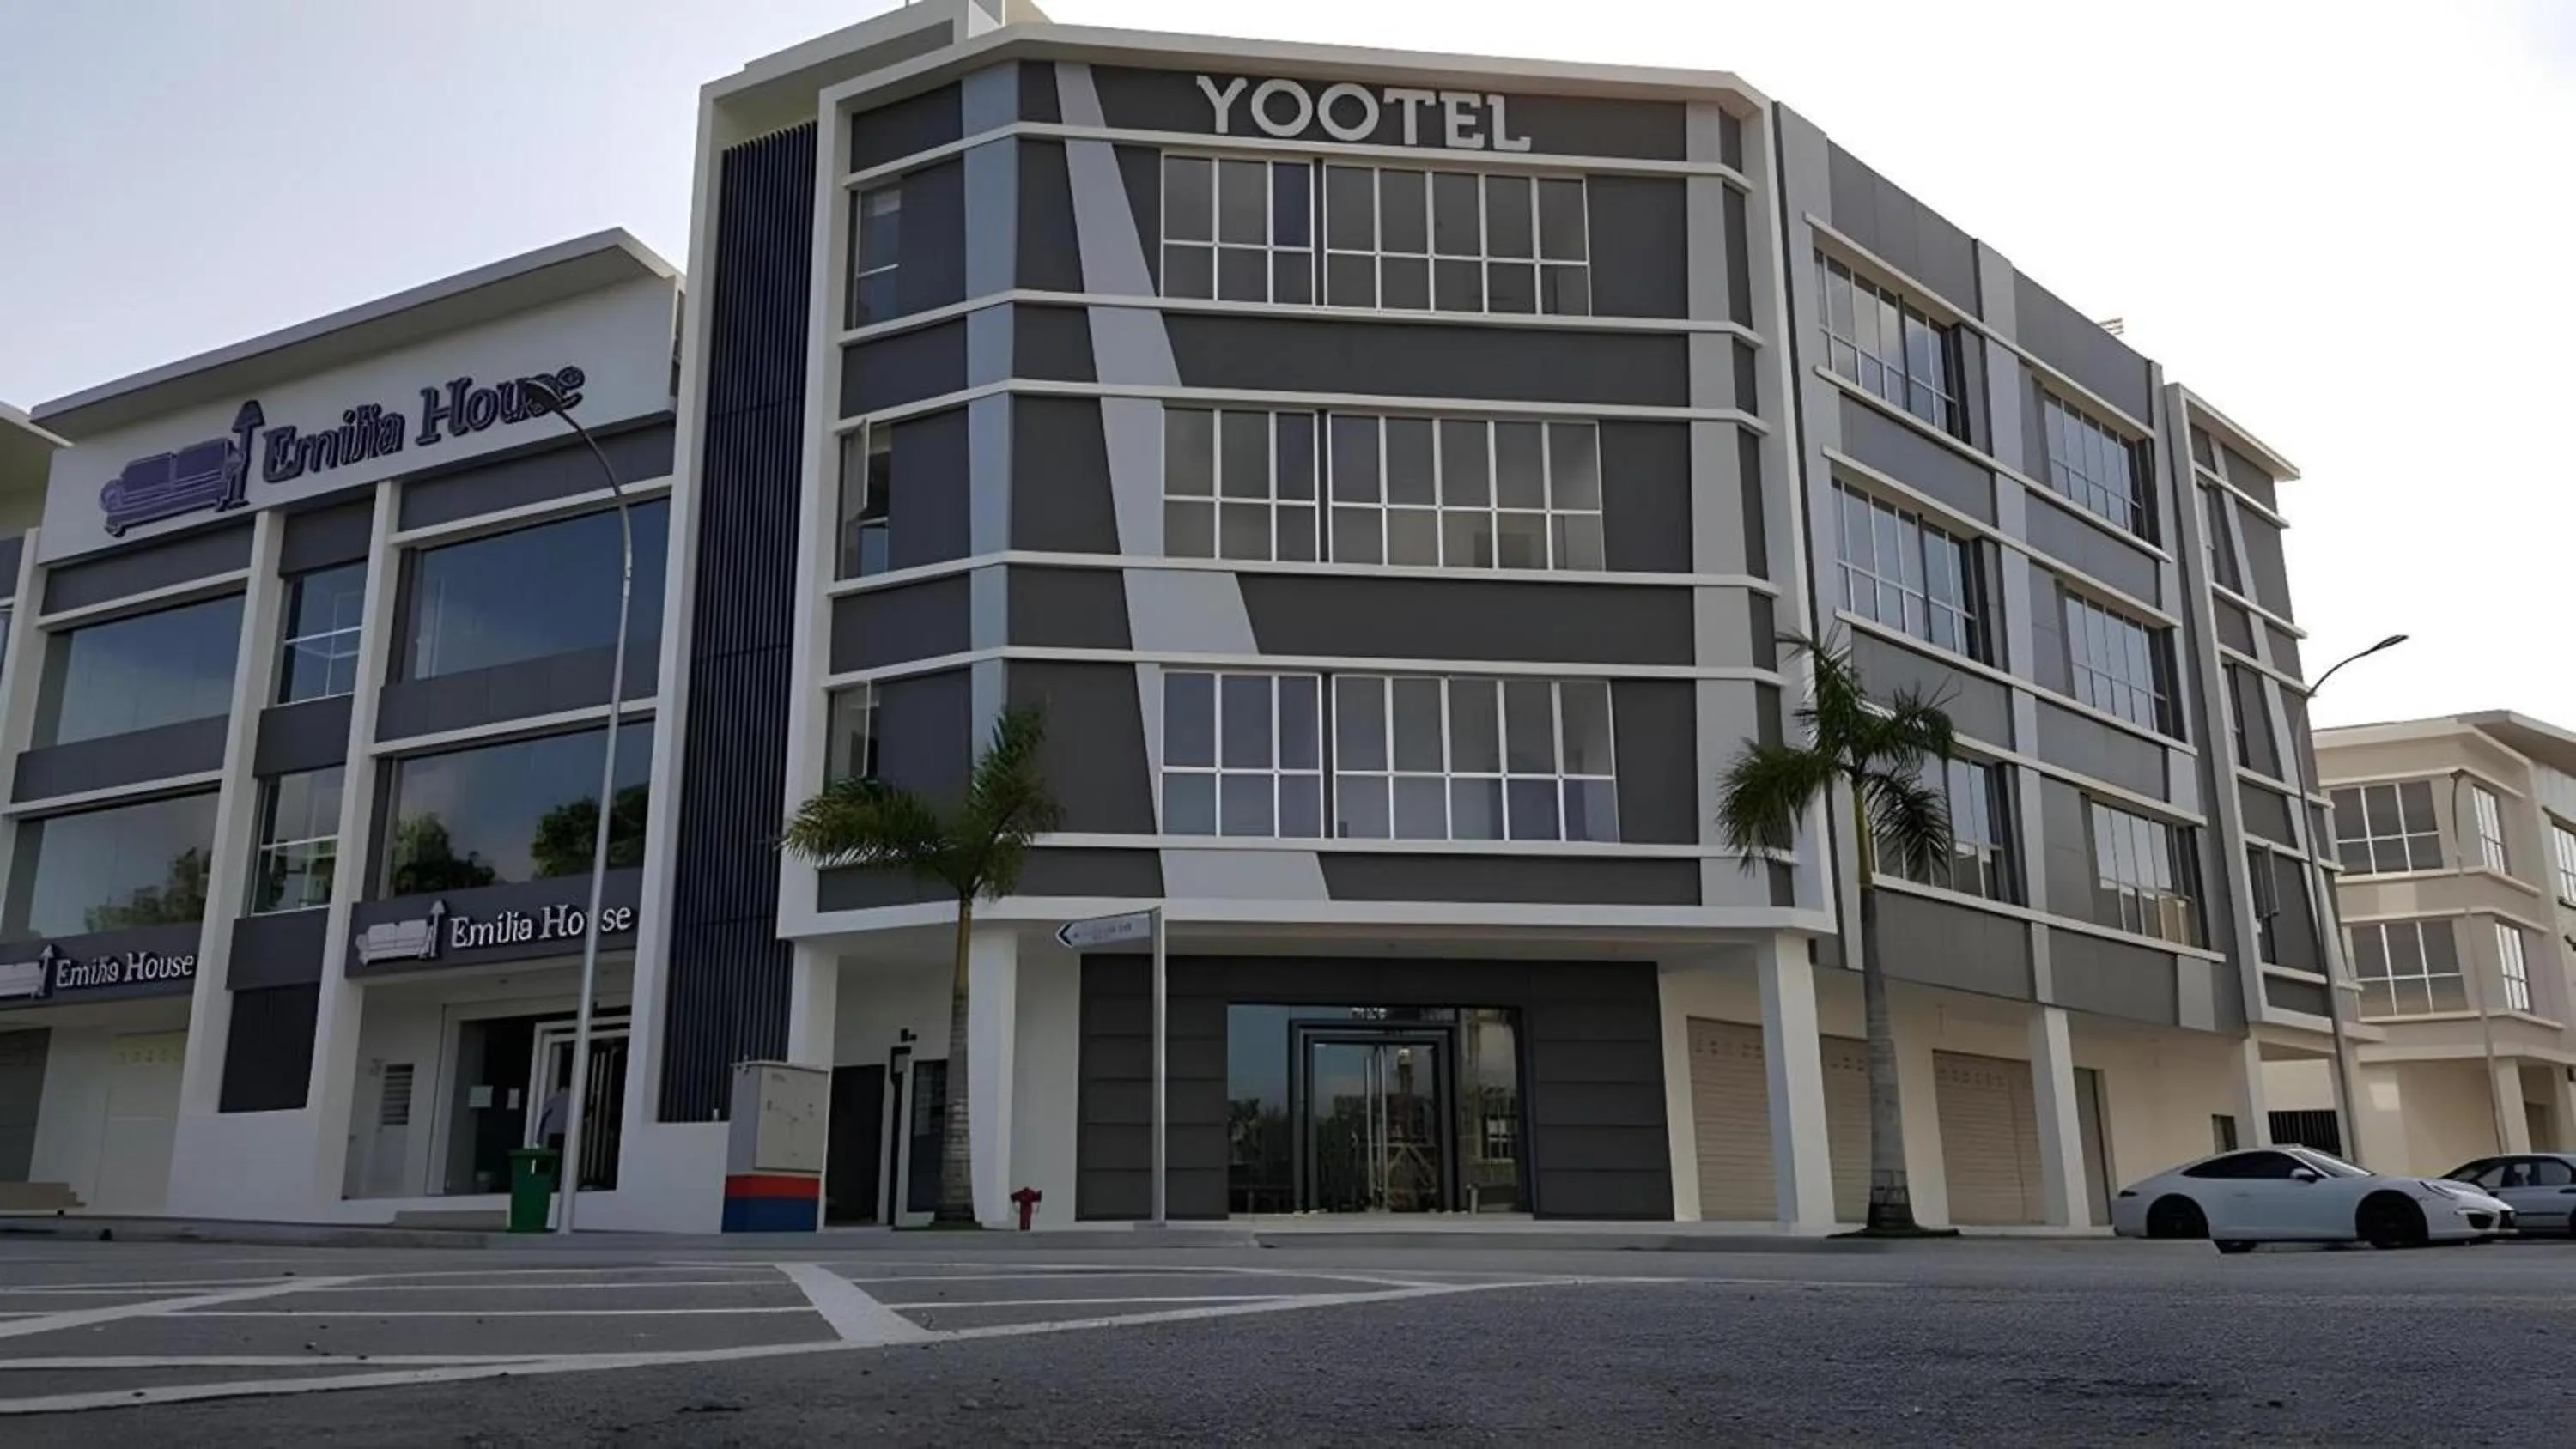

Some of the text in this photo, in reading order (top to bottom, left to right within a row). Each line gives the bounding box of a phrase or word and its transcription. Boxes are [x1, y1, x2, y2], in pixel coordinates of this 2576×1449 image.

[1196, 75, 1532, 152] YOOTEL
[262, 366, 586, 483] Emilia Houe
[450, 904, 632, 949] Emilia Hose
[123, 951, 194, 982] House
